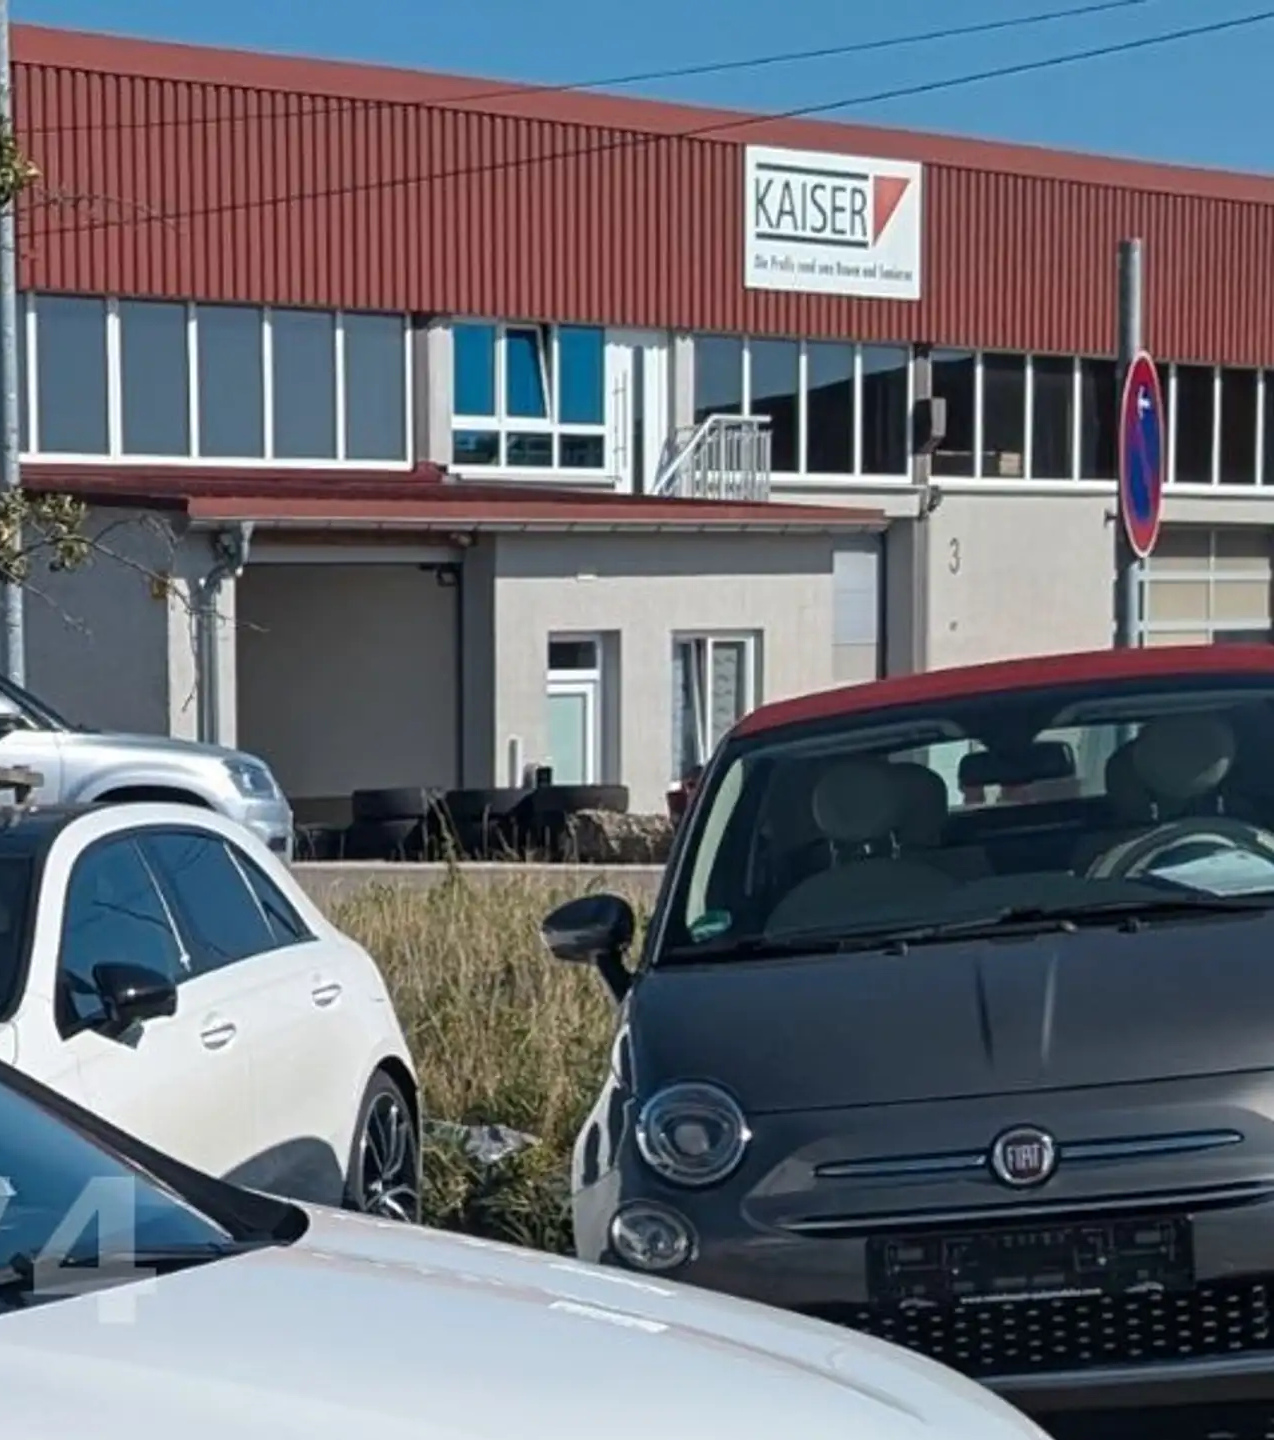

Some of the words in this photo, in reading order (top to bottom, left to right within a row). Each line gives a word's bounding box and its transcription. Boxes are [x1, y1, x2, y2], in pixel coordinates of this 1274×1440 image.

[755, 177, 868, 237] KAISER
[949, 538, 961, 575] 3
[1007, 1143, 1041, 1171] FIAT
